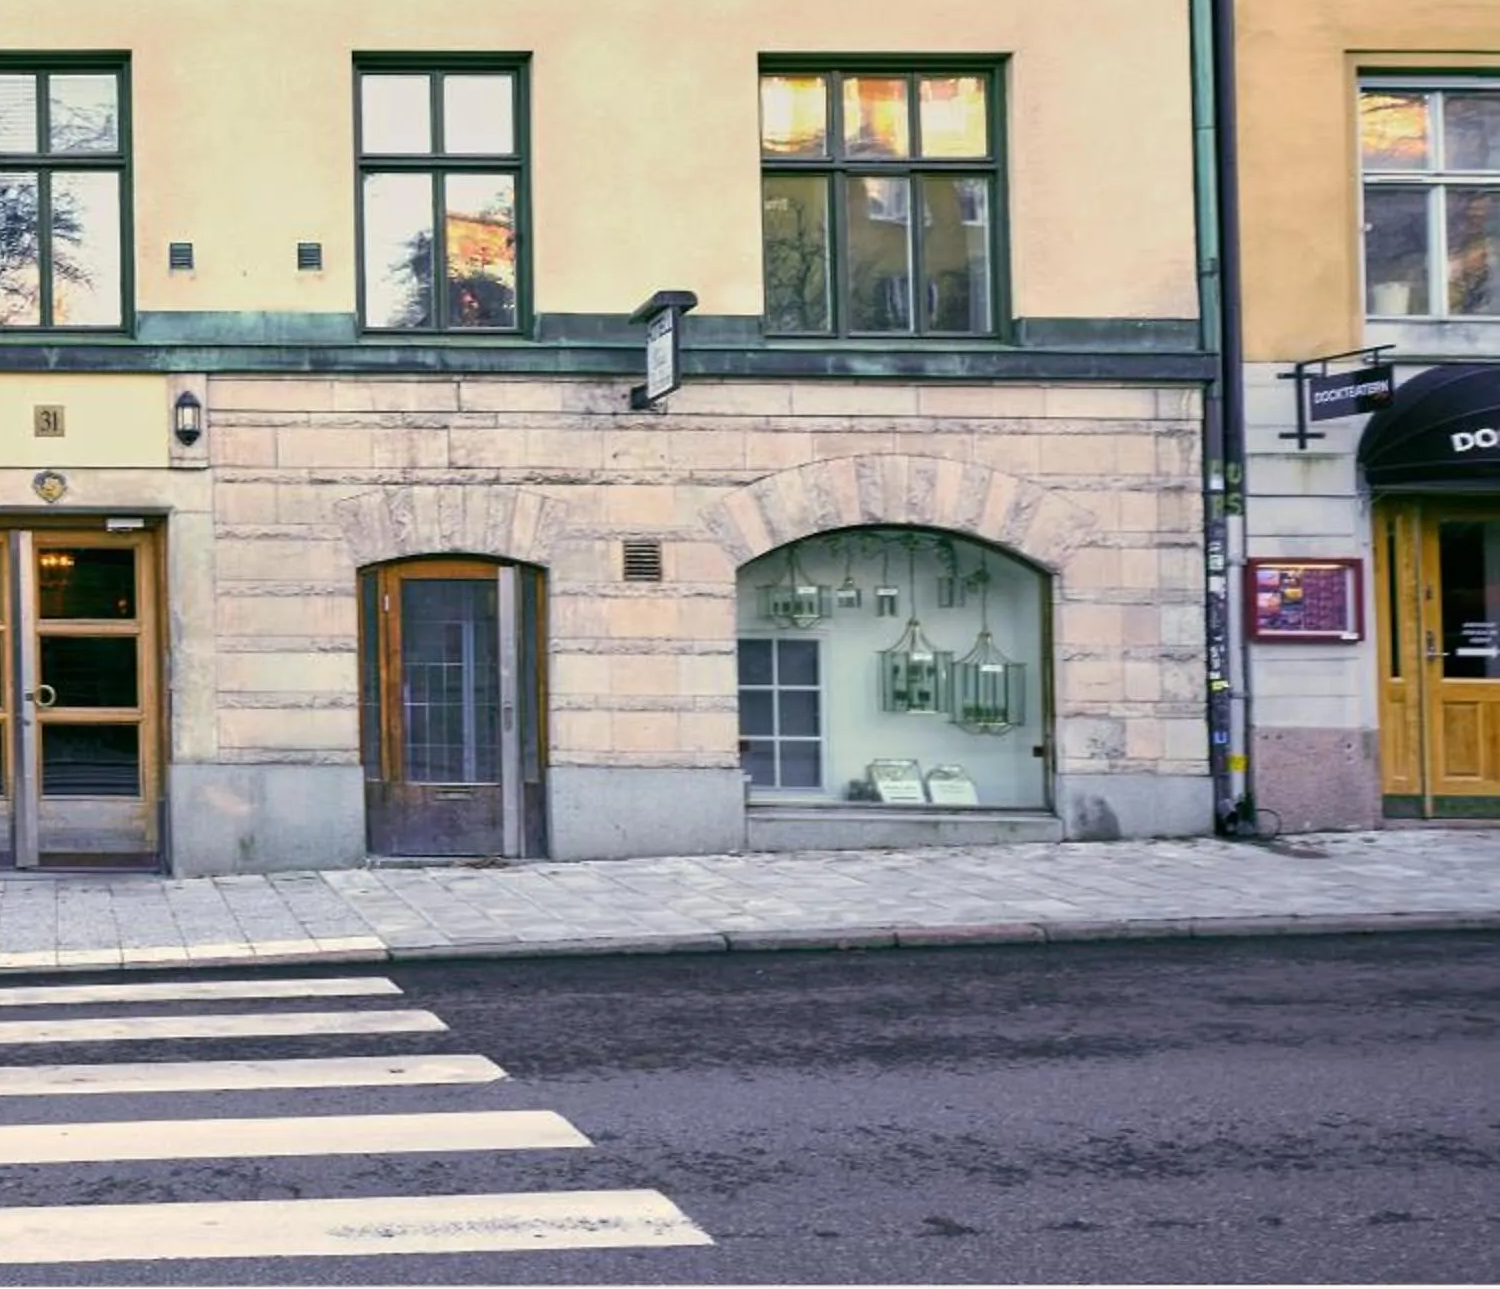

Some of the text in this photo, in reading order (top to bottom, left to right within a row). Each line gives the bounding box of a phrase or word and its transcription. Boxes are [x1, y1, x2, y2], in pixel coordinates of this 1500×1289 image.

[1313, 379, 1389, 404] DOCKTEATERN
[40, 409, 58, 432] 31
[1451, 428, 1500, 452] DO
